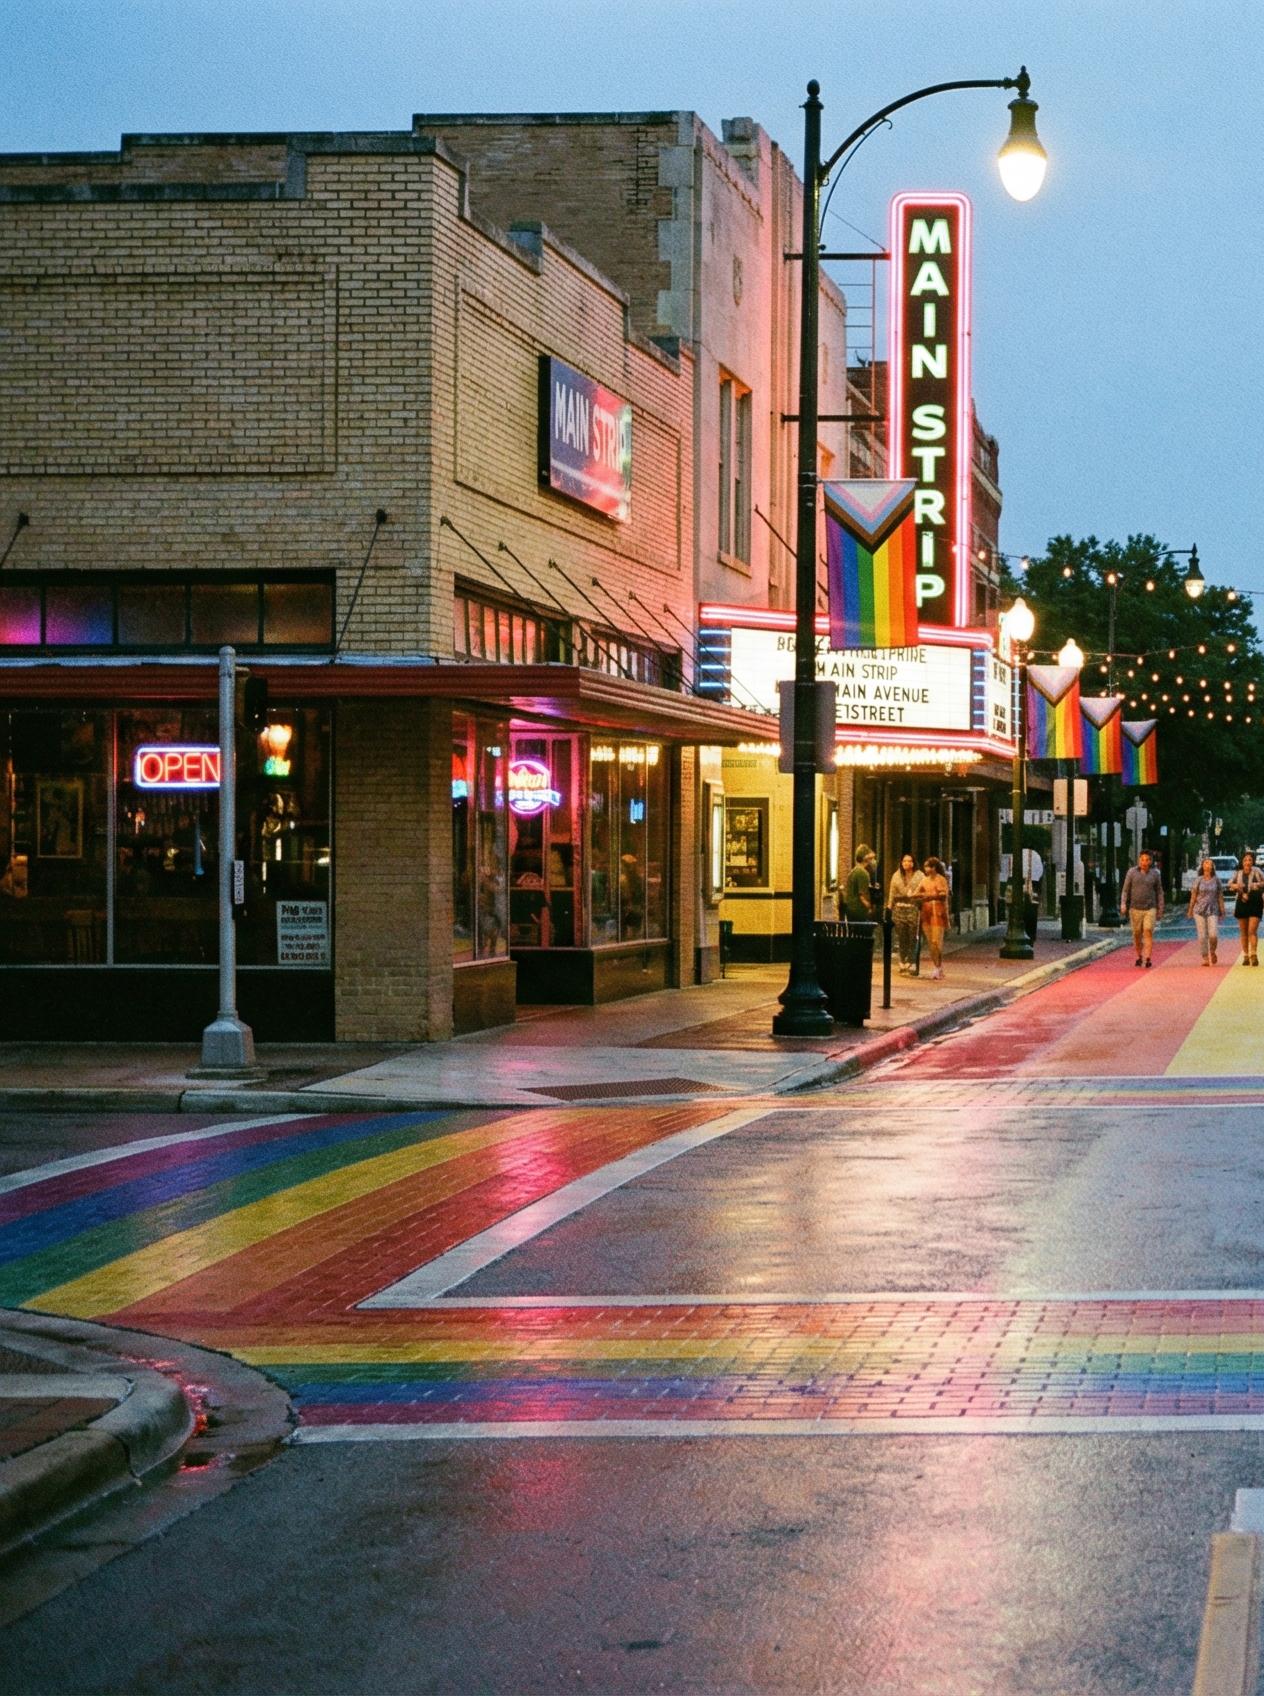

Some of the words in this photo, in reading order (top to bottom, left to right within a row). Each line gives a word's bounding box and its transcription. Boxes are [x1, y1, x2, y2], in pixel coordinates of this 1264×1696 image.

[908, 218, 952, 379] MAIN
[555, 381, 590, 456] MAIN
[911, 404, 947, 609] STRIP
[862, 664, 898, 680] STRIP
[873, 685, 929, 704] AVENUE
[141, 752, 221, 783] OPEN
